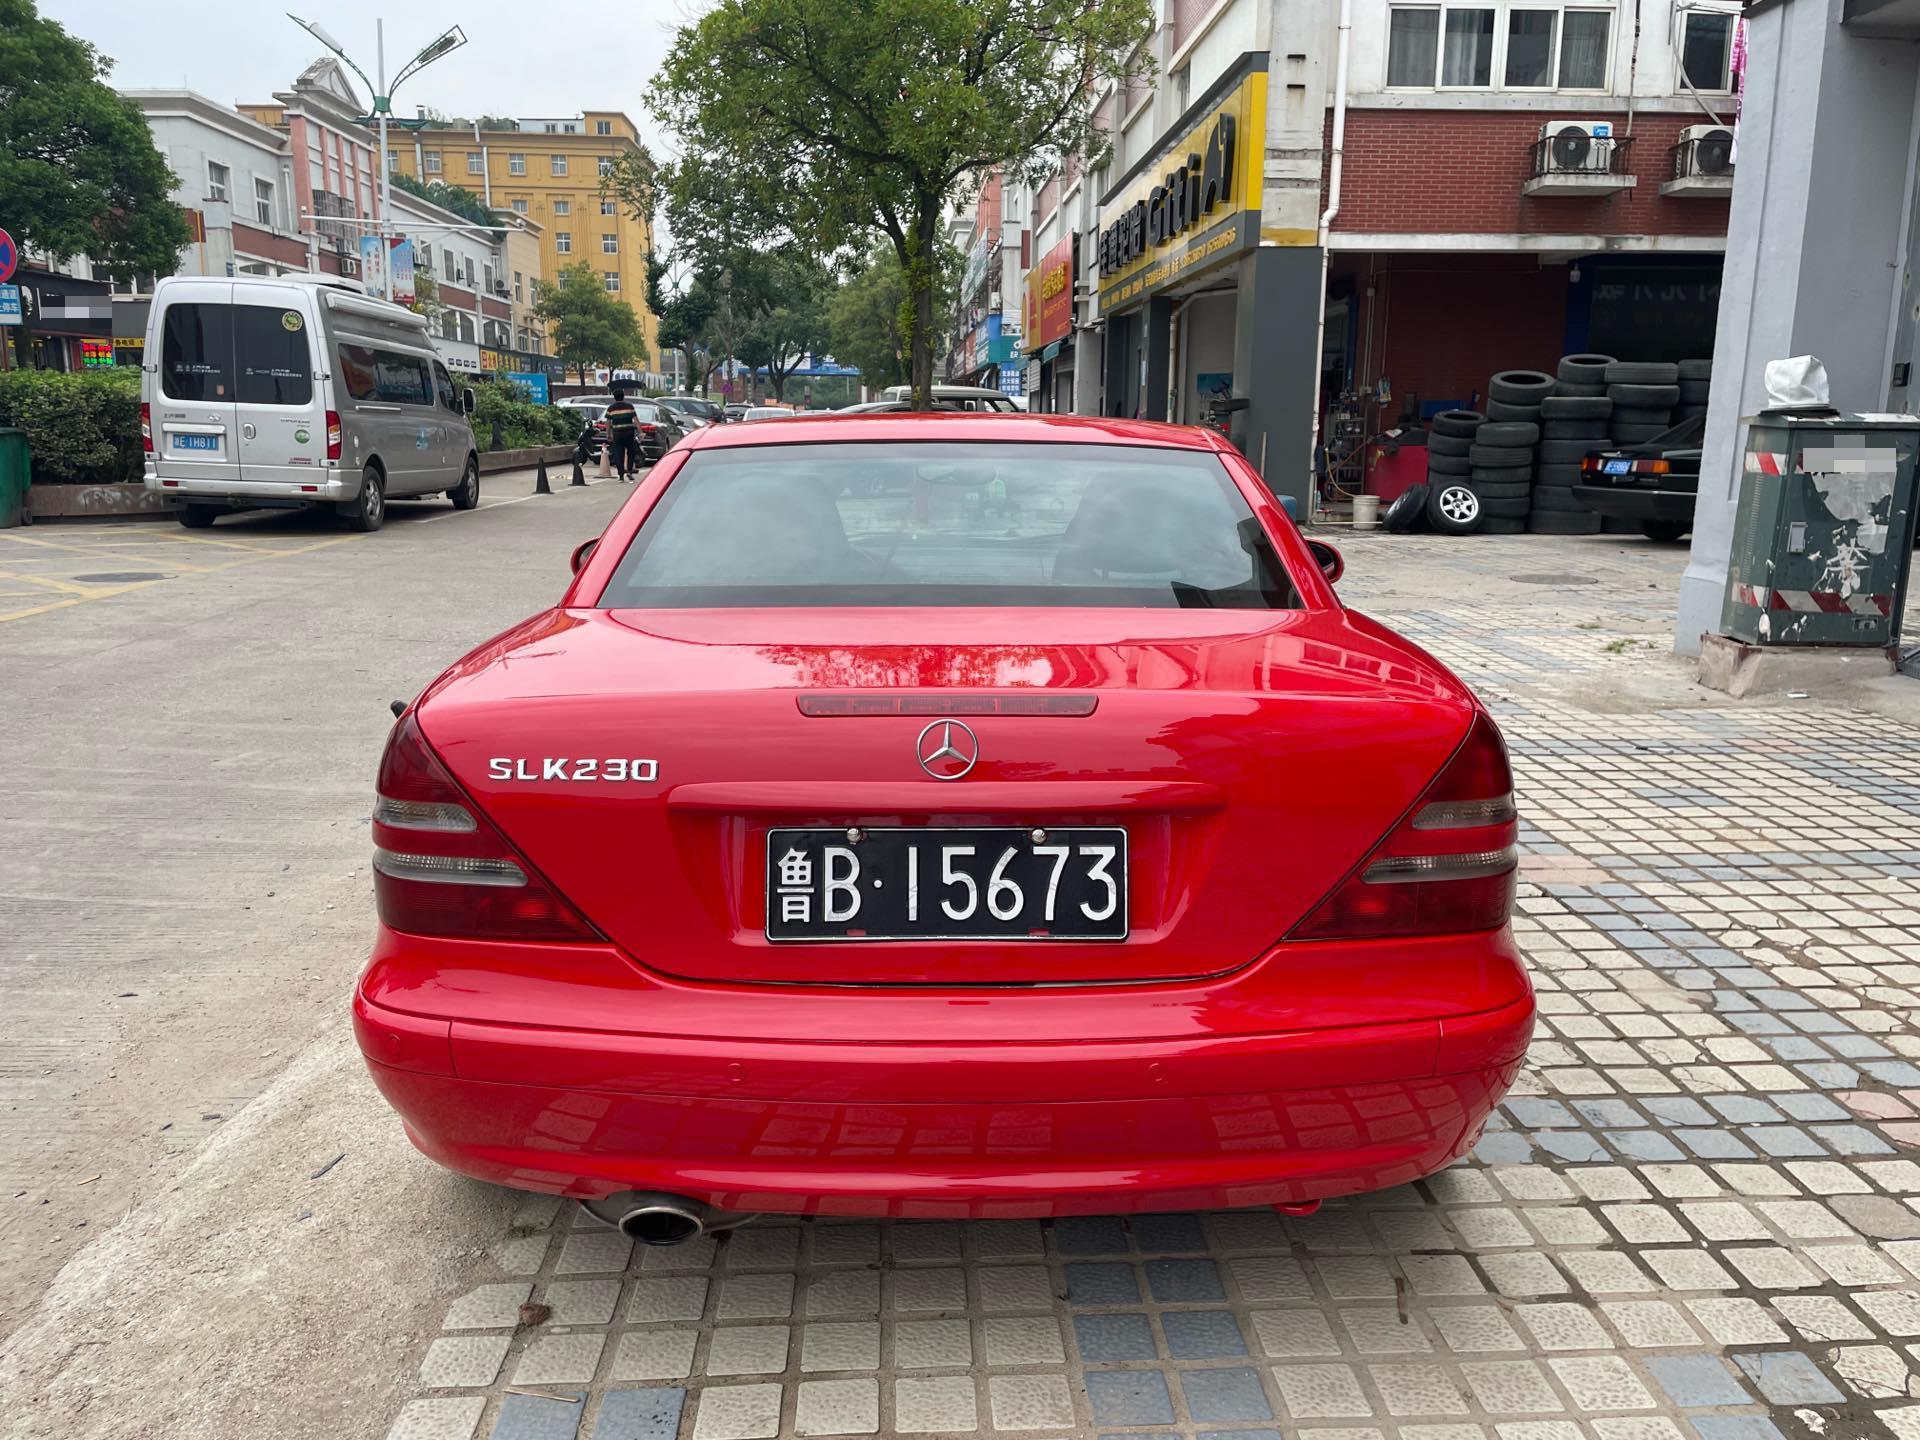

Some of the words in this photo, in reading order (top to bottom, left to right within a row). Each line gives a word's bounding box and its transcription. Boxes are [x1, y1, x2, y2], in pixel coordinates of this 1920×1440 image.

[1149, 153, 1201, 247] Giti
[488, 757, 660, 782] SLK230
[777, 845, 1117, 922] 鲁B·15673
